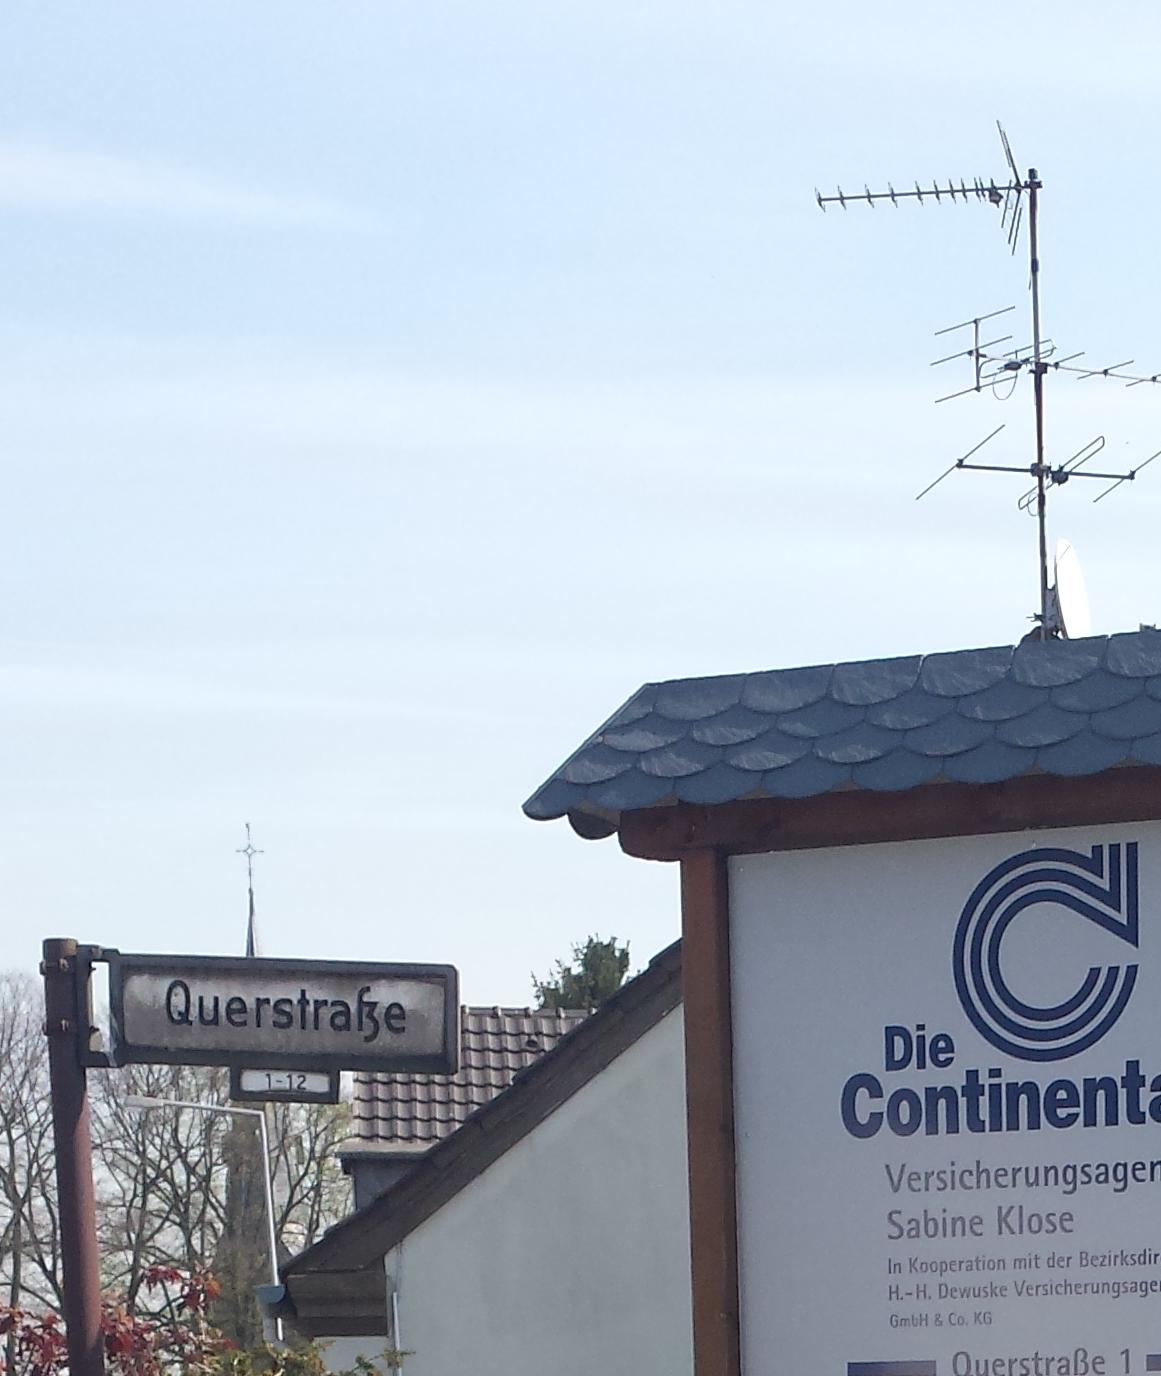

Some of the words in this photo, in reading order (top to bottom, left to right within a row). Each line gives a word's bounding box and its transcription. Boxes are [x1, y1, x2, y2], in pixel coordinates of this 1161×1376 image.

[165, 980, 406, 1042] Querstraße
[884, 1023, 955, 1071] Die
[265, 1073, 306, 1091] 1-12
[887, 1209, 984, 1239] Sabine
[997, 1205, 1074, 1236] Klose
[888, 1258, 902, 1274] In
[909, 1254, 1005, 1276] Kooperation
[1013, 1253, 1040, 1270] mit
[1046, 1251, 1072, 1268] der
[889, 1283, 932, 1300] H.-H.
[938, 1280, 1008, 1299] Dewuske
[890, 1313, 928, 1328] GmbH
[935, 1313, 942, 1326] &
[948, 1313, 968, 1326] Co.
[974, 1311, 992, 1325] KG
[1120, 1348, 1131, 1374] 1
